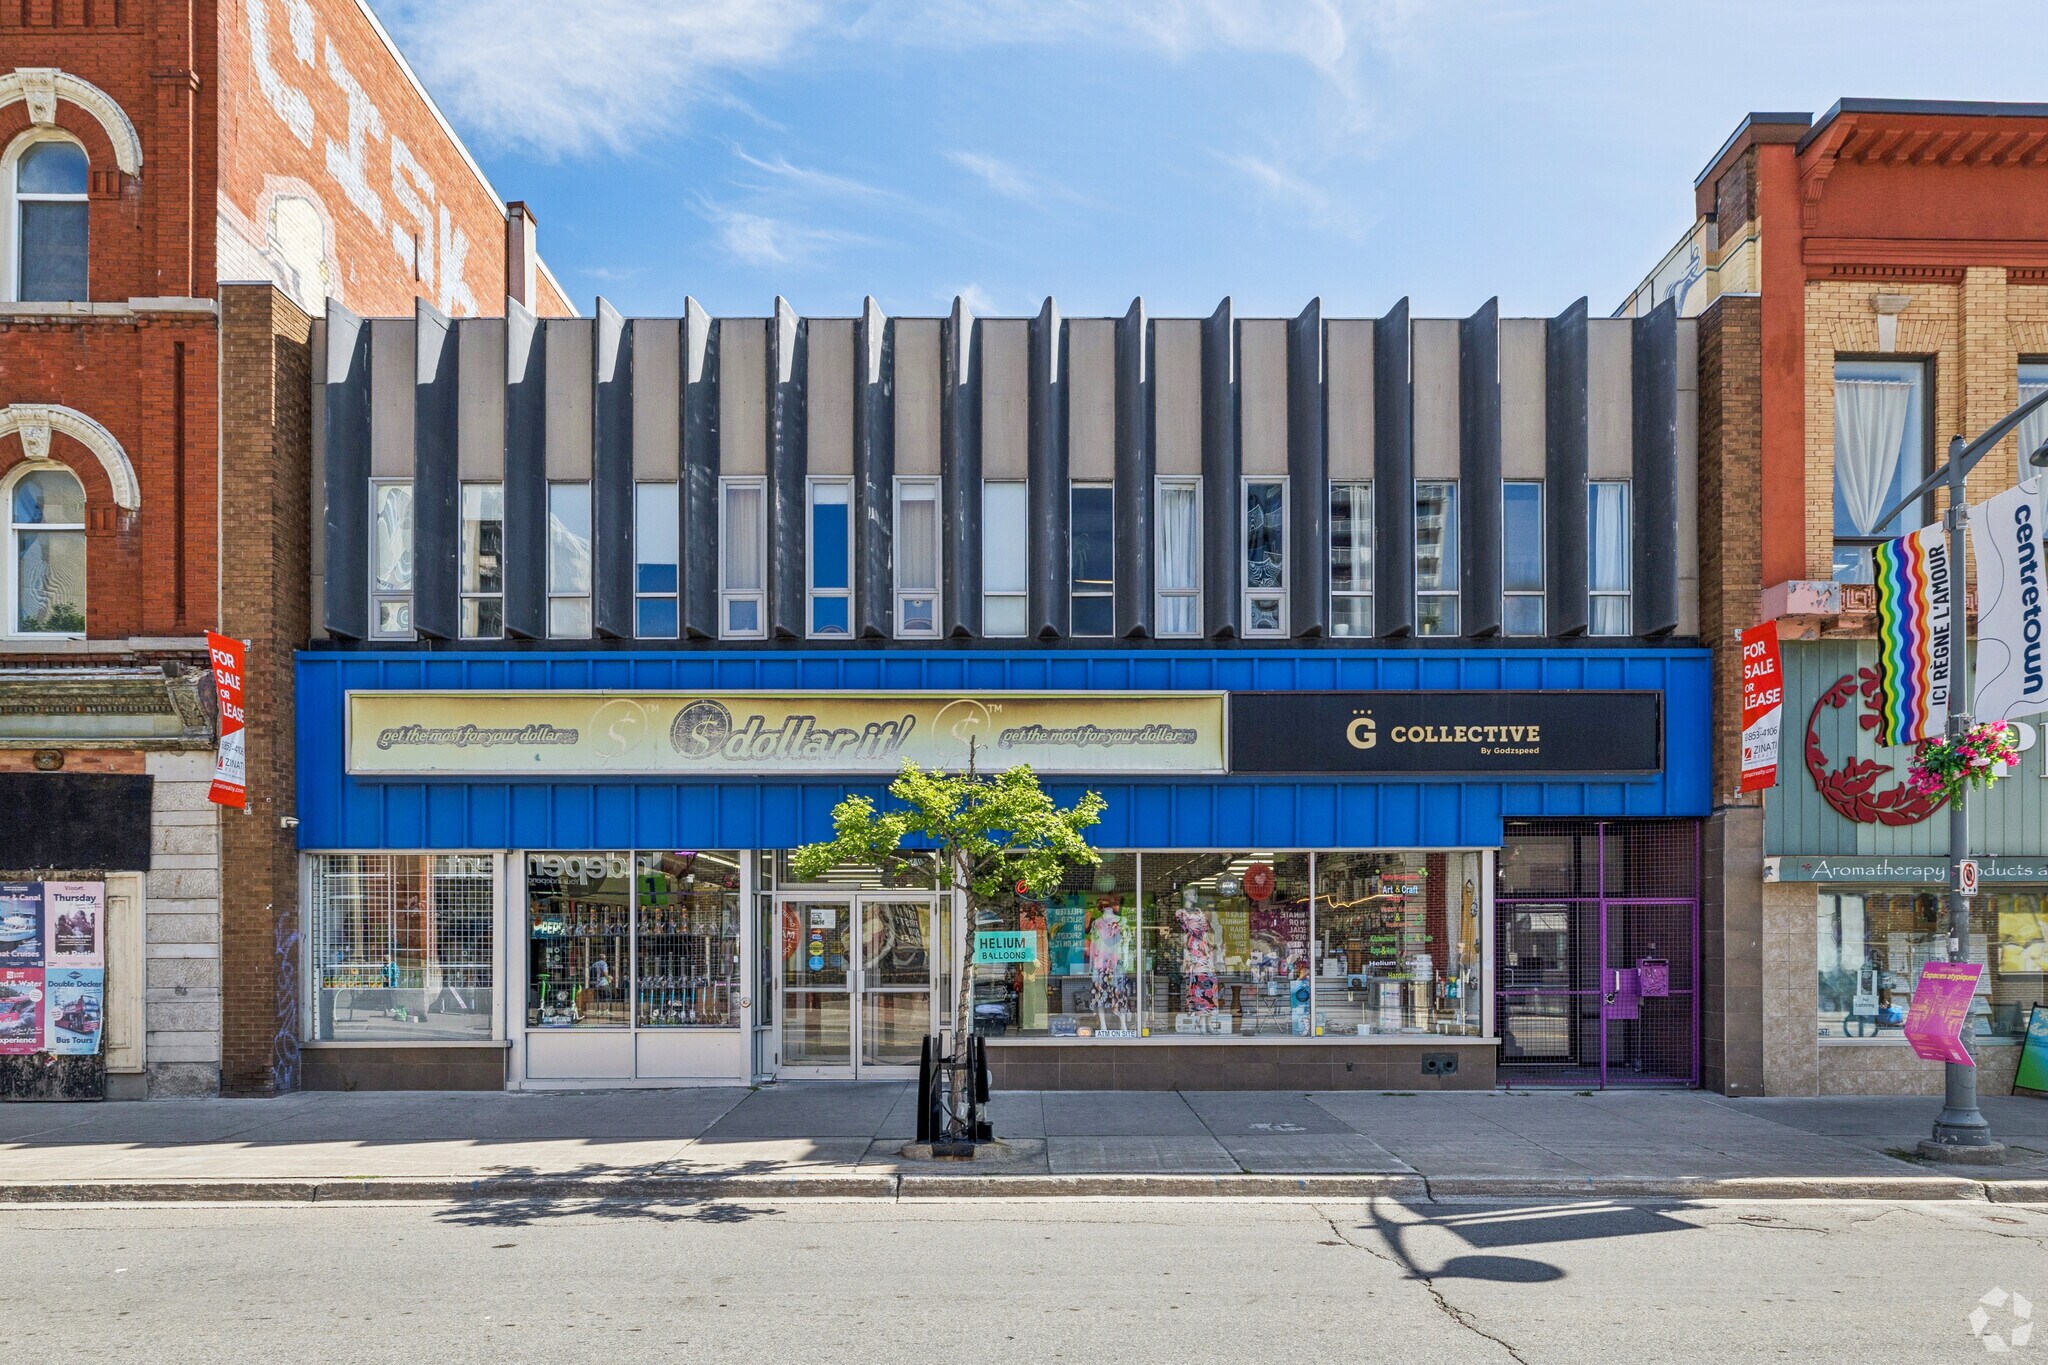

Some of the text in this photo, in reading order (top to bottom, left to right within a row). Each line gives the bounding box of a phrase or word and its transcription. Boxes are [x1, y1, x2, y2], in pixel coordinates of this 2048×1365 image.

[2014, 504, 2044, 696] centretown
[1928, 543, 1950, 706] ICI RÈGNE L'AMOUR
[1743, 640, 1767, 660] FOR
[211, 648, 236, 669] FOR
[1744, 658, 1775, 680] SALE
[216, 669, 241, 691] SALE
[1744, 682, 1755, 693] OR
[220, 689, 231, 700] OR
[1744, 687, 1782, 711] LEASE
[222, 700, 245, 724] LEASE
[380, 728, 404, 747] get
[405, 725, 427, 742] the
[427, 728, 462, 742] most
[460, 726, 485, 745] for
[483, 730, 520, 746] your
[520, 726, 562, 742] dollar
[1001, 729, 1025, 747] get
[1026, 727, 1048, 742] the
[1049, 728, 1081, 742] most
[1078, 726, 1105, 746] for
[1104, 730, 1140, 746] your
[1139, 726, 1182, 742] dollar
[1390, 725, 1541, 743] COLLECTIVE
[1480, 746, 1541, 756] By Godzspeed
[1753, 741, 1778, 755] ZINATI
[225, 757, 245, 770] ZINAT
[1811, 858, 1946, 883] Aromatherapy
[1382, 885, 1394, 894] Art
[1401, 885, 1419, 894] Craft
[53, 893, 97, 904] Thursday
[979, 937, 1026, 949] HELIUM
[11, 950, 40, 958] Cruises
[982, 951, 1027, 960] BALLOONS
[48, 980, 102, 988] Double Decker
[56, 1036, 94, 1044] Bus Tours
